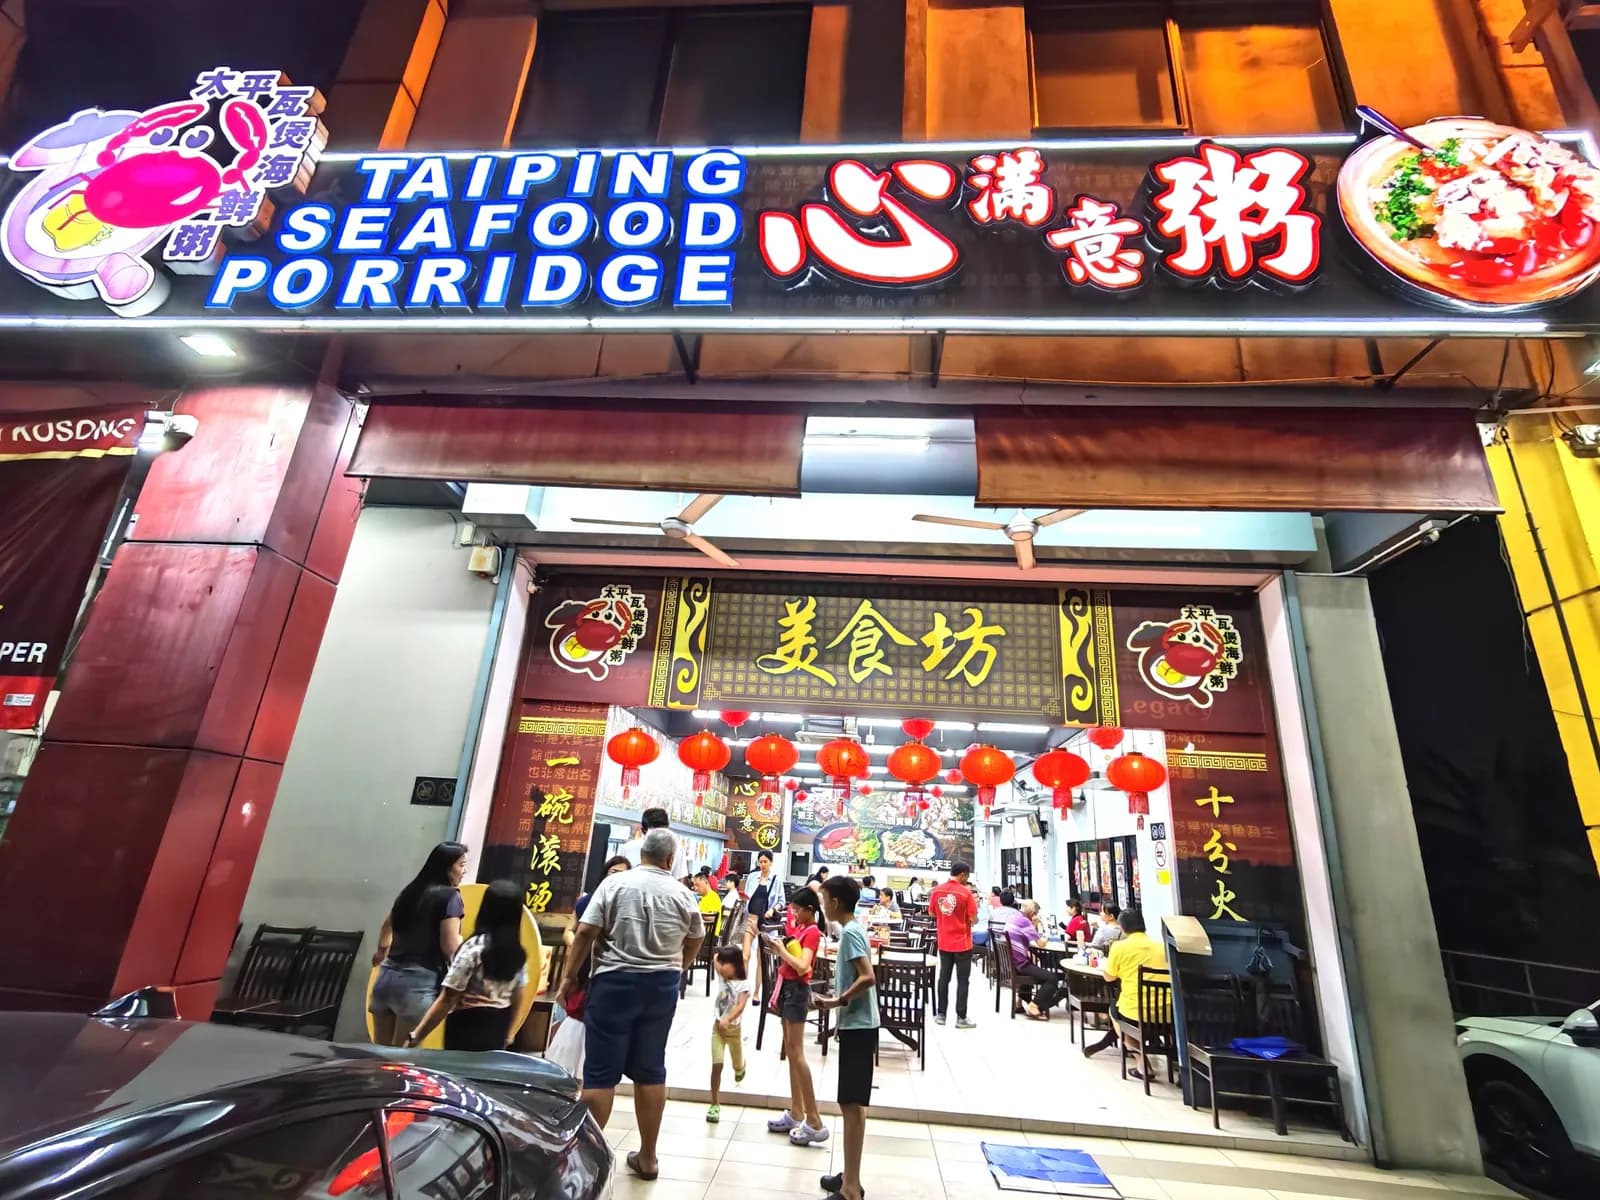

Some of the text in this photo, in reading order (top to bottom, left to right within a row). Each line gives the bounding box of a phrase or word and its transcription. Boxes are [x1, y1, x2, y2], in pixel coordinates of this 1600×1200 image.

[358, 150, 746, 200] TAIPING
[278, 201, 741, 252] SEAFOOD
[205, 251, 735, 308] PORRIDGE
[756, 596, 1006, 687] 美食坊
